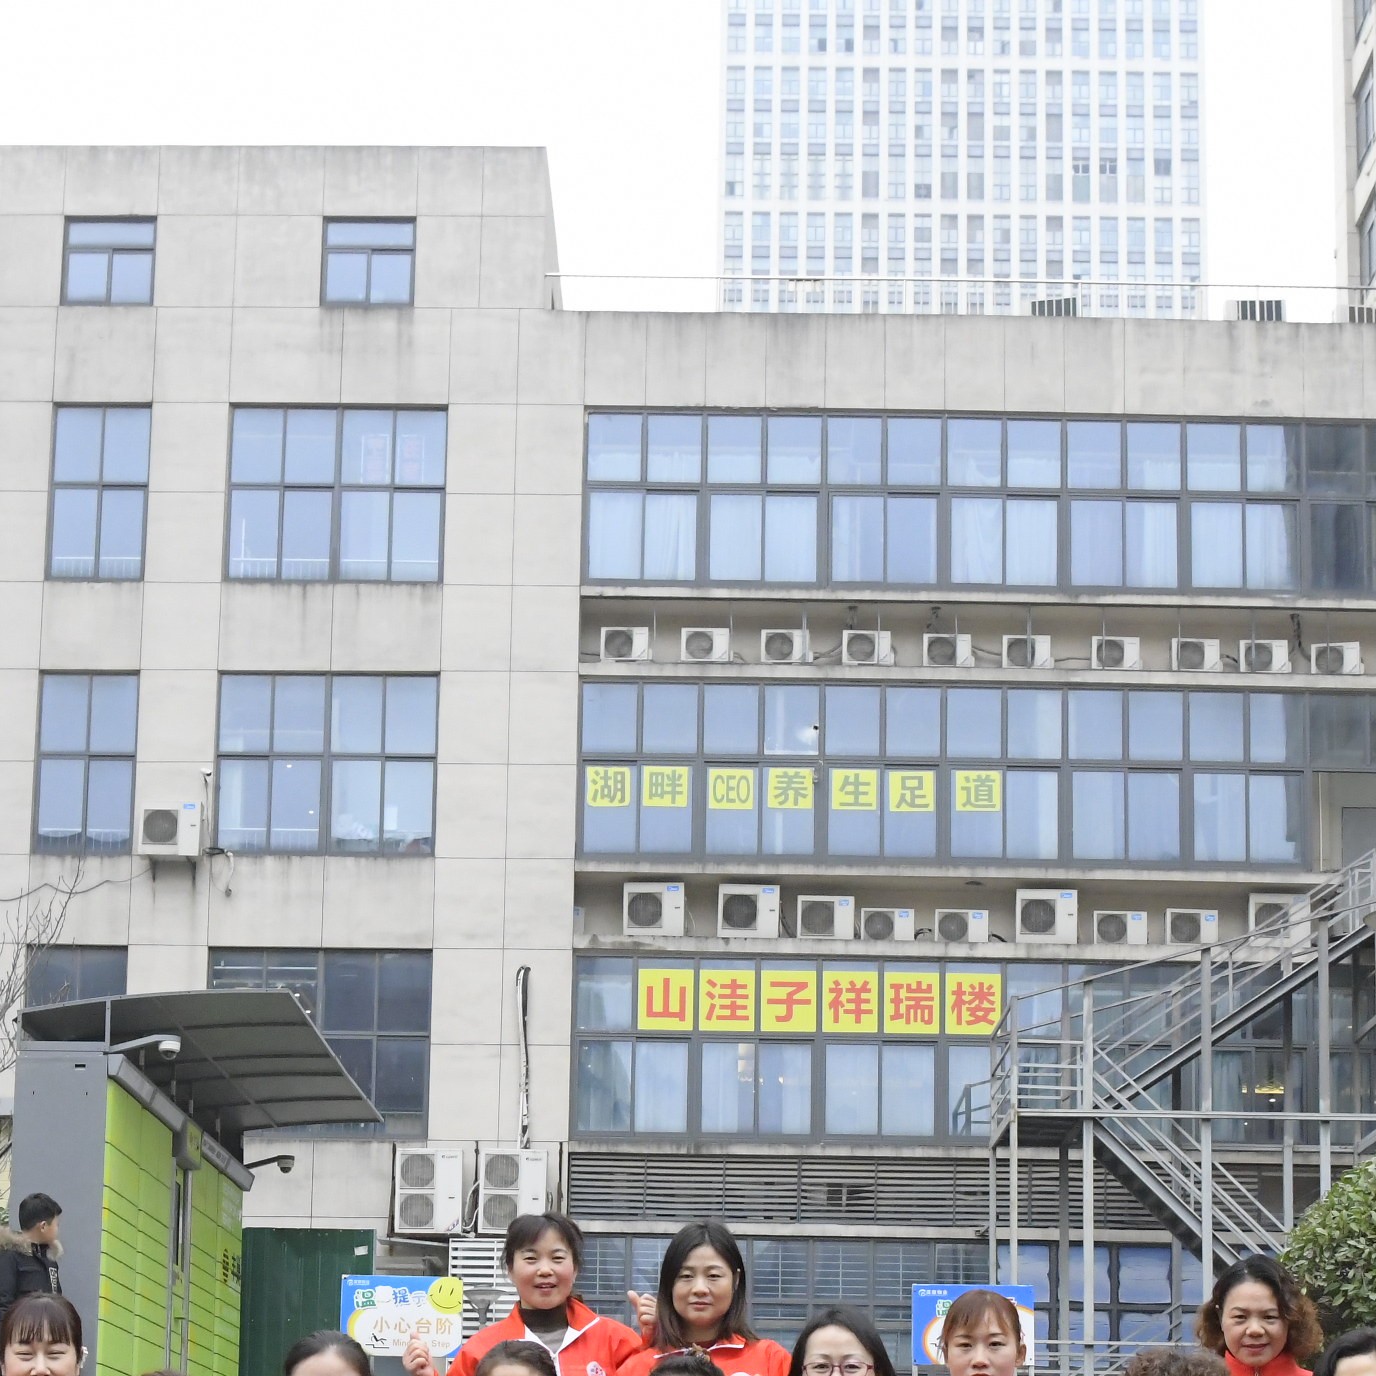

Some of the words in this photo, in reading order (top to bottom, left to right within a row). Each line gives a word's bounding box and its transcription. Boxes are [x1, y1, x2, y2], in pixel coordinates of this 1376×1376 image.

[591, 769, 997, 809] 湖畔CEO养生足道
[645, 976, 997, 1027] 山洼子祥瑞楼
[355, 1287, 427, 1308] 温提示
[372, 1316, 454, 1335] 小心台阶
[431, 1340, 451, 1349] Step
